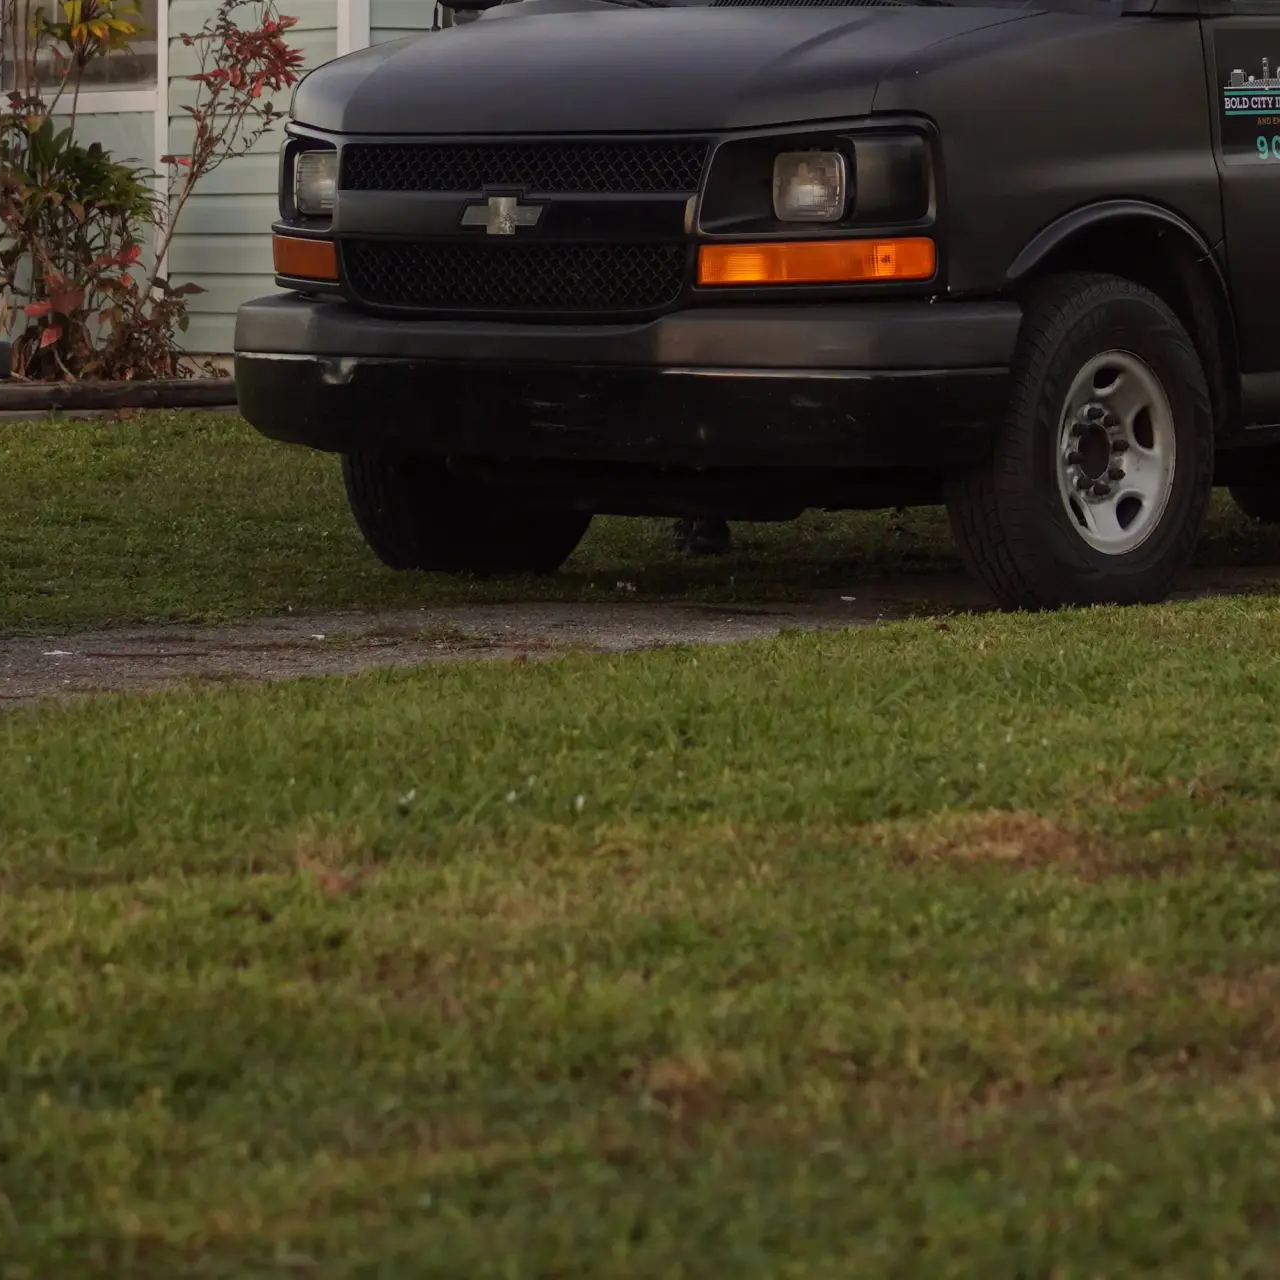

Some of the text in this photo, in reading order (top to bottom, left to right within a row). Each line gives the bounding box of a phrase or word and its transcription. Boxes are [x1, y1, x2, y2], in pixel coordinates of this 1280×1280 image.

[1224, 97, 1249, 109] BOLD
[1251, 96, 1273, 108] CITY
[1257, 117, 1271, 125] AND
